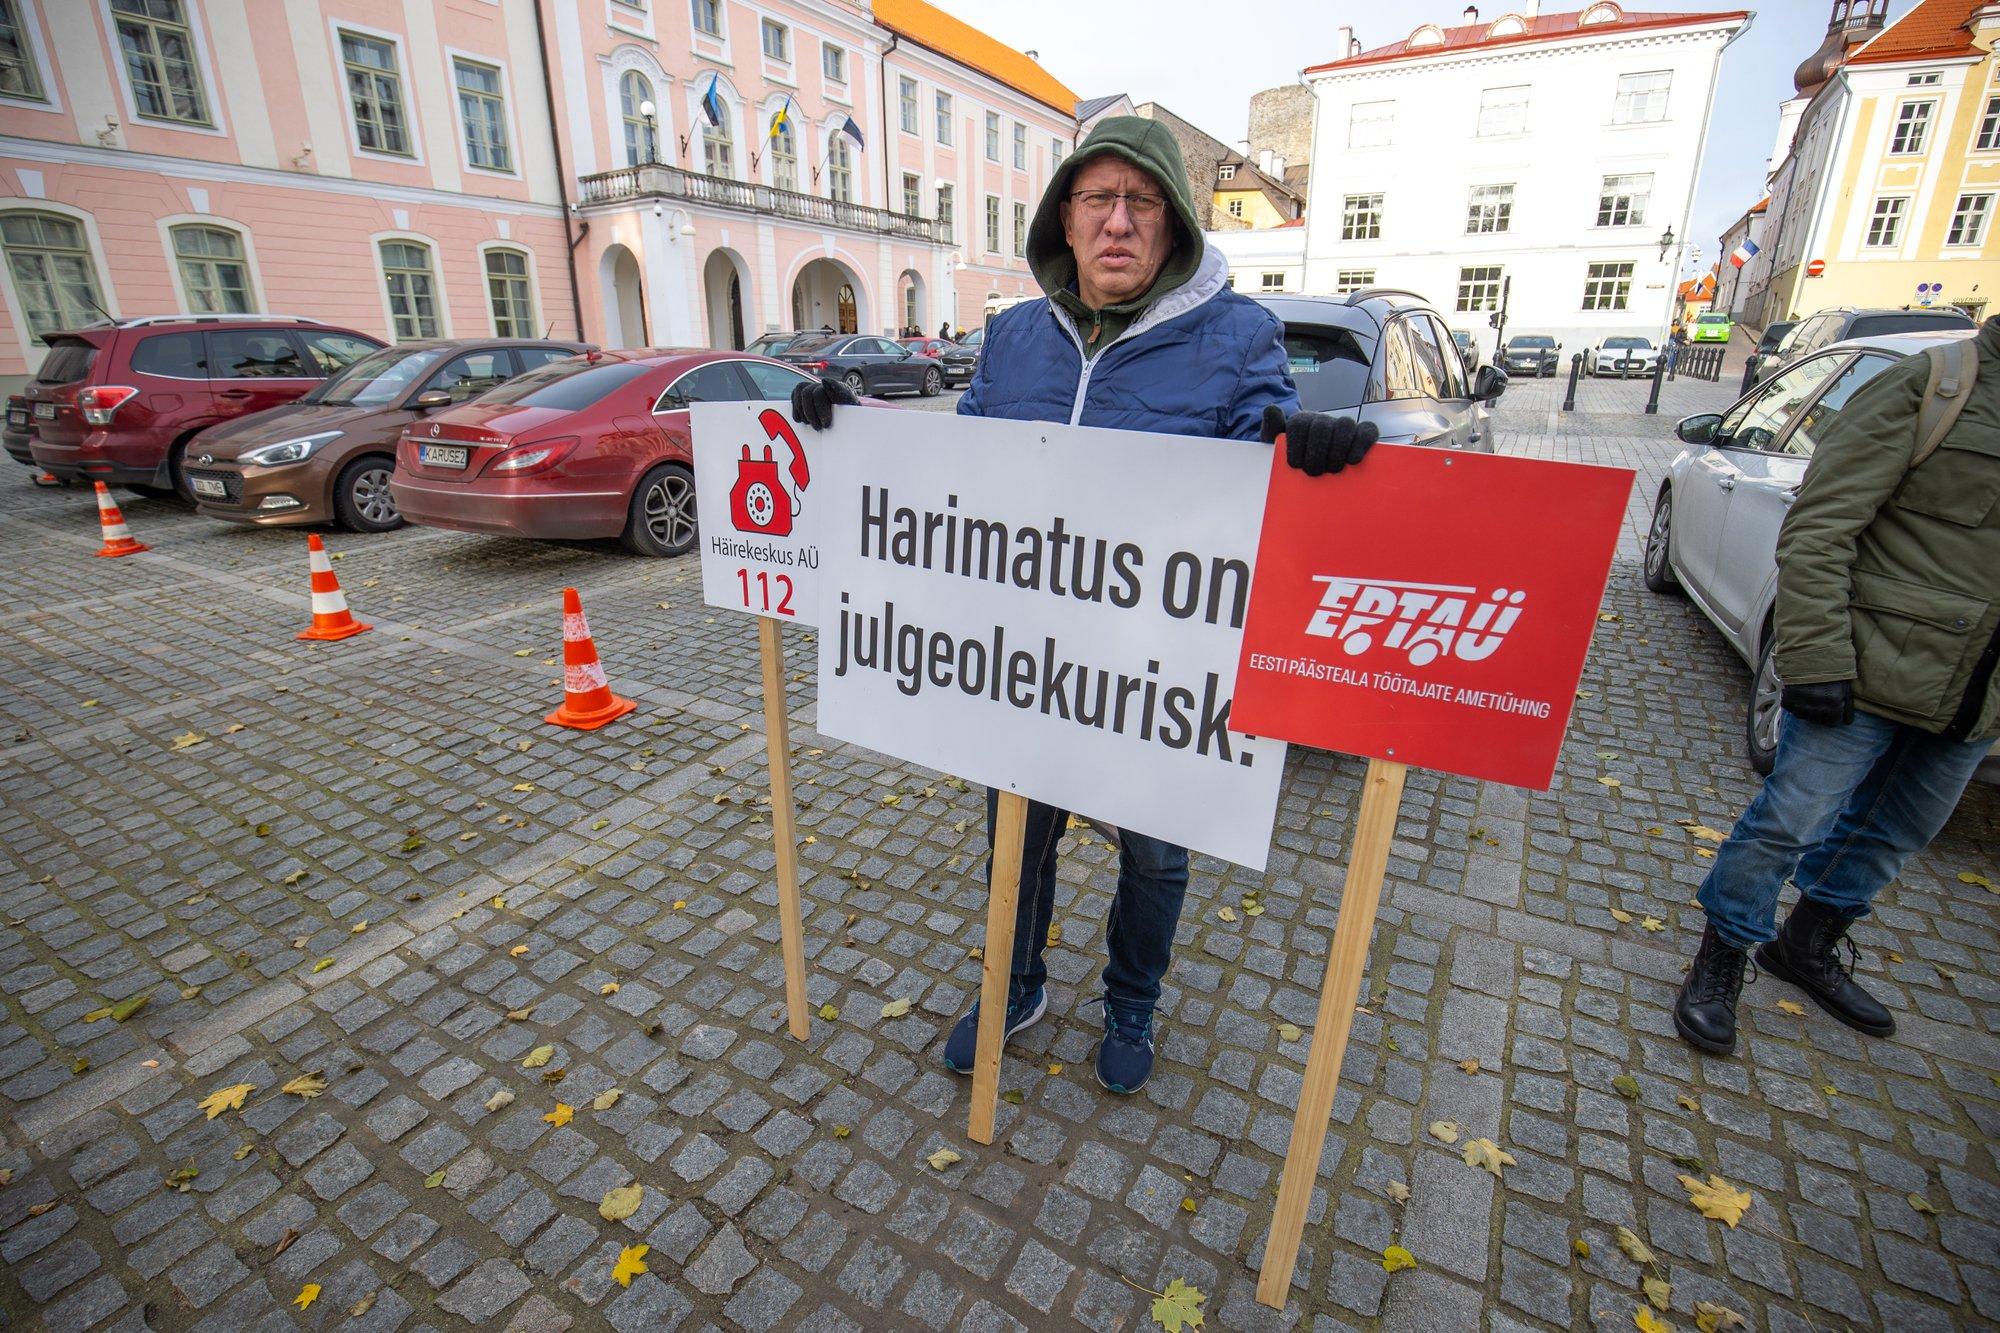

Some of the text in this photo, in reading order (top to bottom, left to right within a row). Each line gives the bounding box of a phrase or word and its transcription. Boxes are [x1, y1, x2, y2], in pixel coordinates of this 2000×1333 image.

[425, 447, 465, 464] KARUSE2
[711, 536, 819, 570] Häirekeskus AÜ
[860, 485, 1250, 629] Harimatus on
[736, 568, 796, 616] 112
[1304, 575, 1528, 667] EPTAÜ
[1249, 653, 1551, 720] EESTI PÄÄSTEALA TÖÖTAJATE AMETIÜHING
